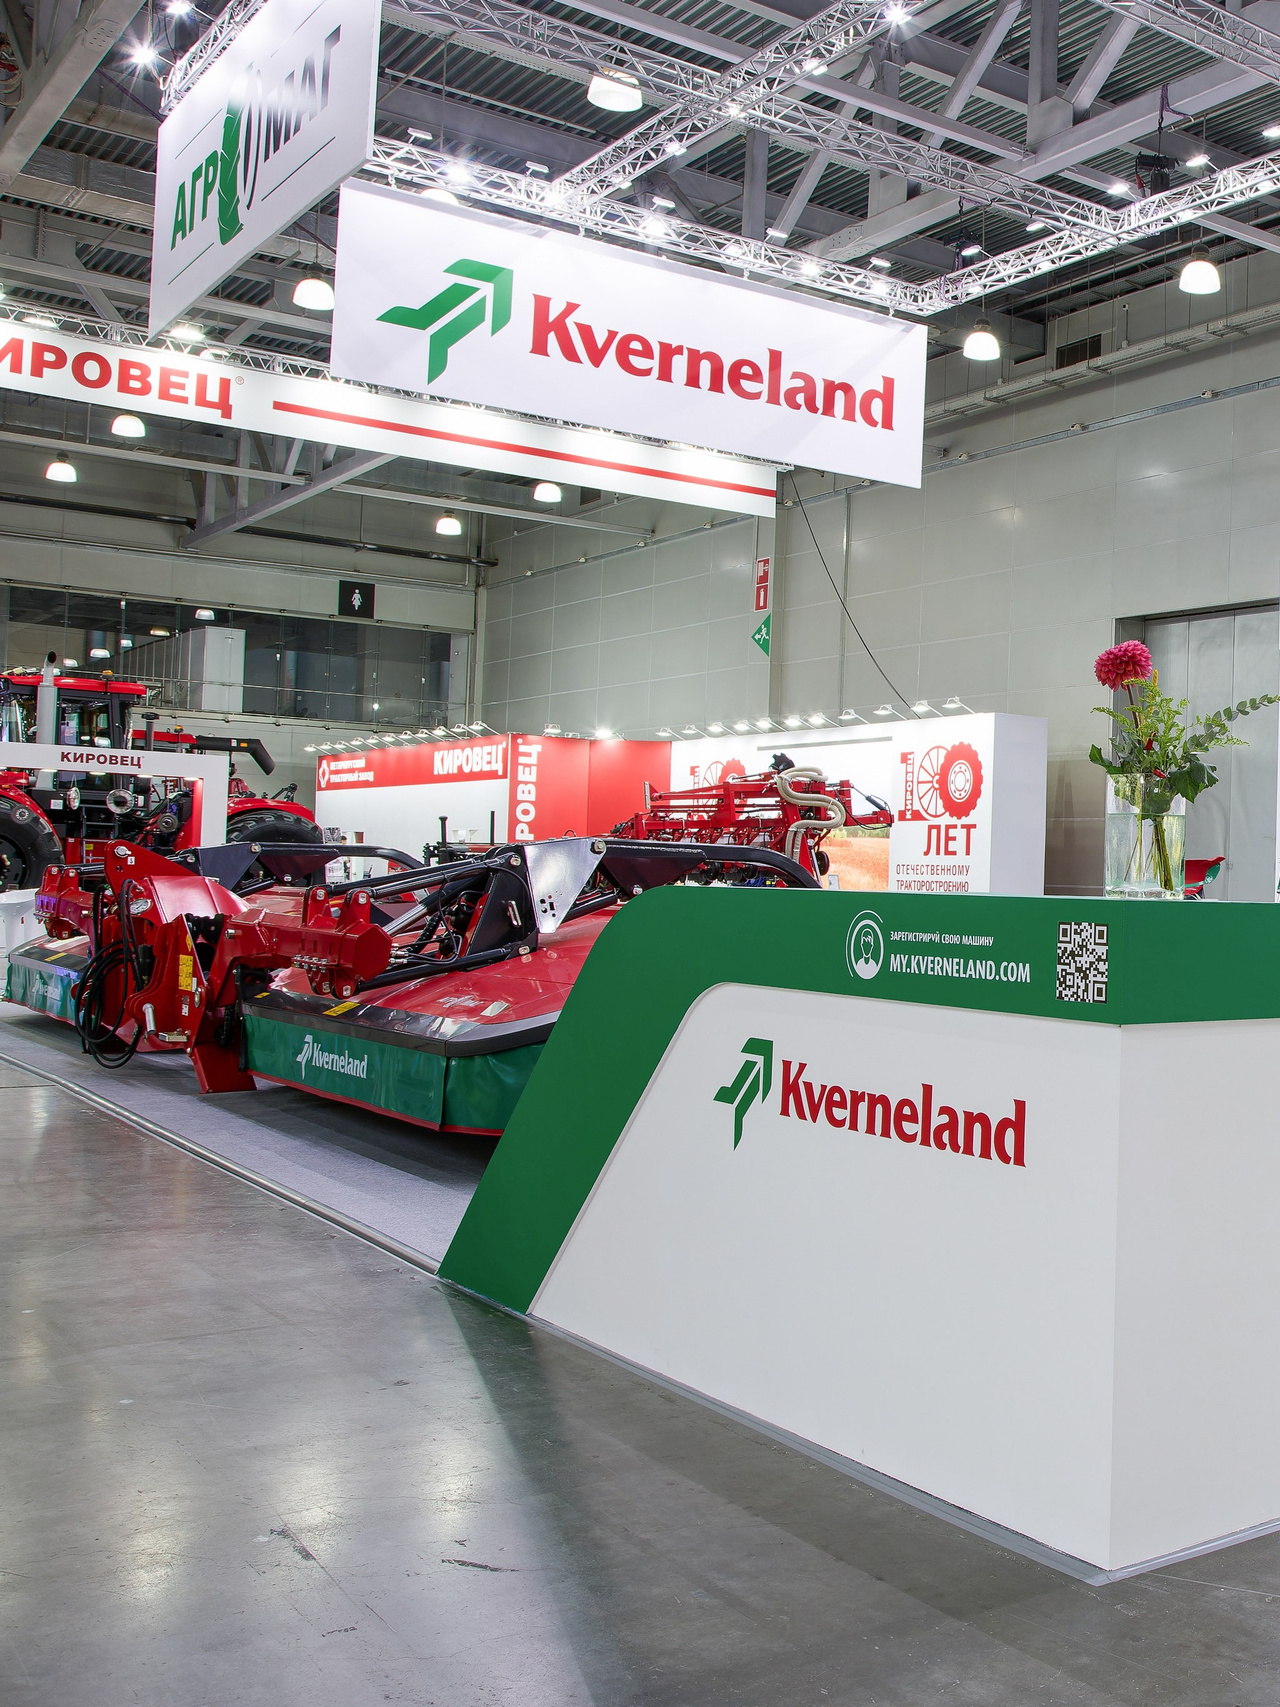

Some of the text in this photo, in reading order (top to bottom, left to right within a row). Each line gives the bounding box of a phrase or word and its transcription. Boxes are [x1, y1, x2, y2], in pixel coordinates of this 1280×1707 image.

[528, 293, 896, 432] Kverneland
[60, 751, 142, 769] КИРОВЕЦ
[433, 744, 504, 776] КИРОВЕЦ
[923, 823, 977, 857] ЛЕТ
[896, 864, 970, 877] ОТЕЧЕСТВЕННОМУ
[896, 879, 970, 893] ТРАКТОРОСТРОЕНИЮ
[890, 931, 994, 947] ЗАРЕГИСТРИРУЙ СВОЮ МАШИНУ
[889, 953, 1031, 983] MY.KVERNELAND.COM
[312, 1042, 368, 1079] Kverneland
[779, 1059, 1027, 1168] Kverneland
